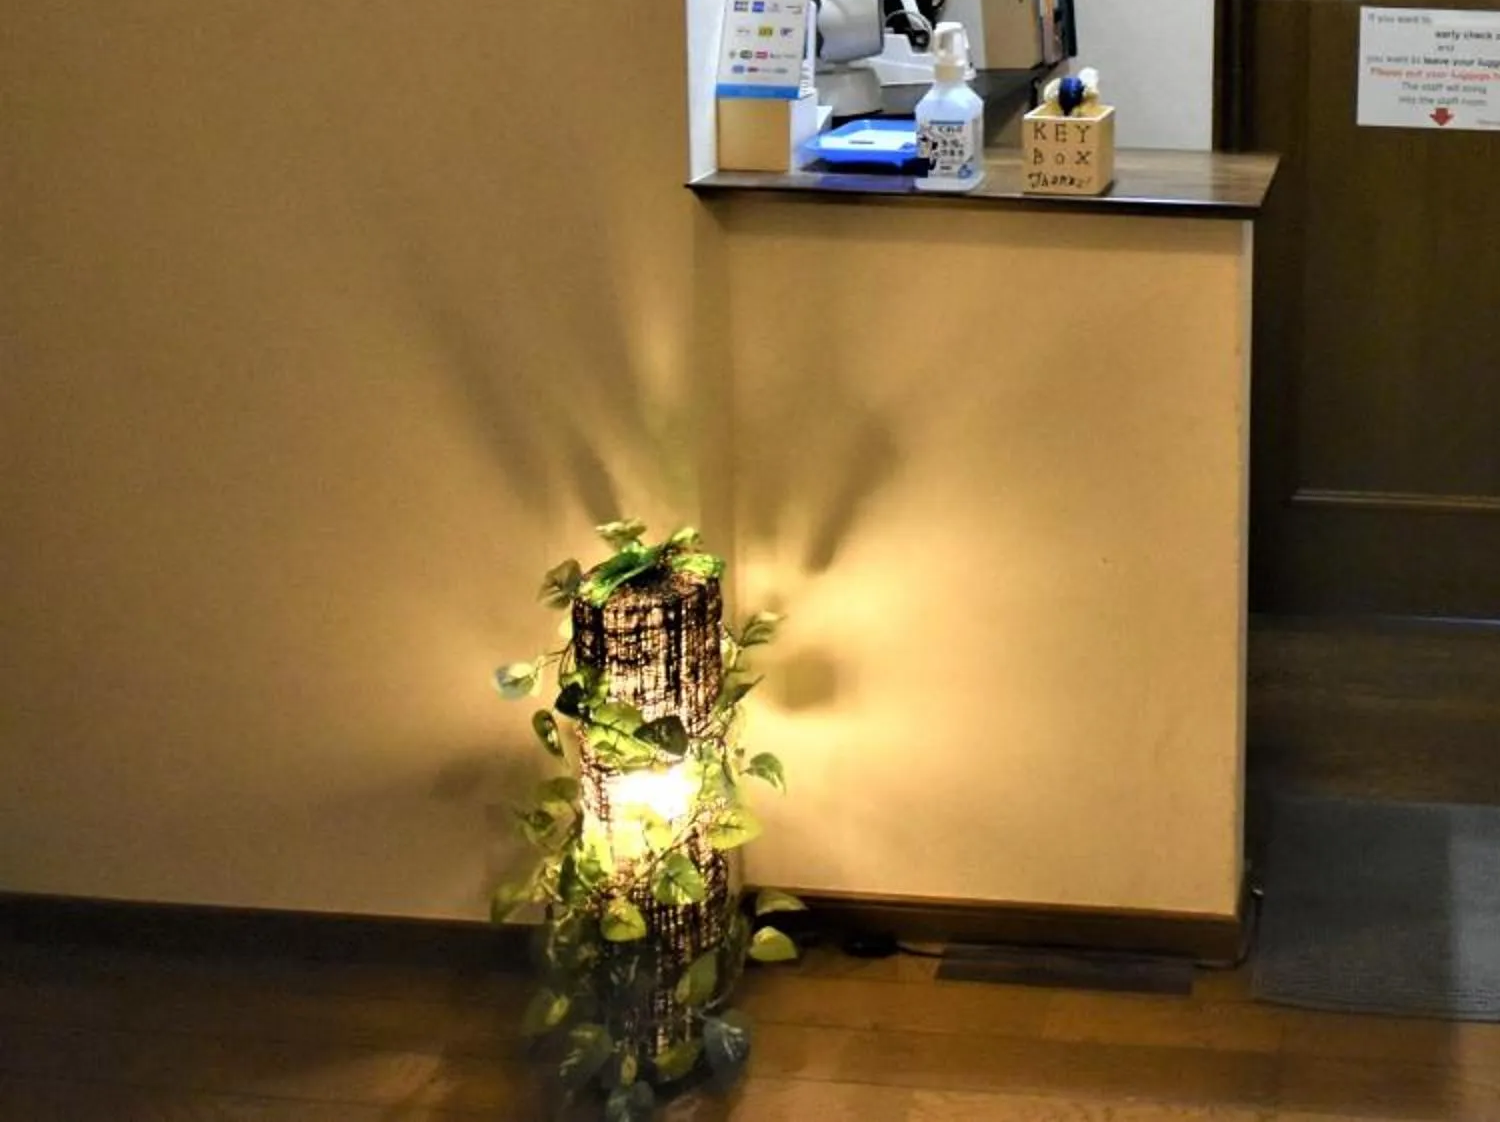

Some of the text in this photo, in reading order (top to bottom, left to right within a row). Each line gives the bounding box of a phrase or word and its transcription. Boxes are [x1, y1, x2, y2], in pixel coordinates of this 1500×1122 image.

[1434, 30, 1460, 41] early
[1463, 30, 1493, 41] check
[1421, 82, 1443, 92] staff
[1033, 121, 1091, 143] KEY
